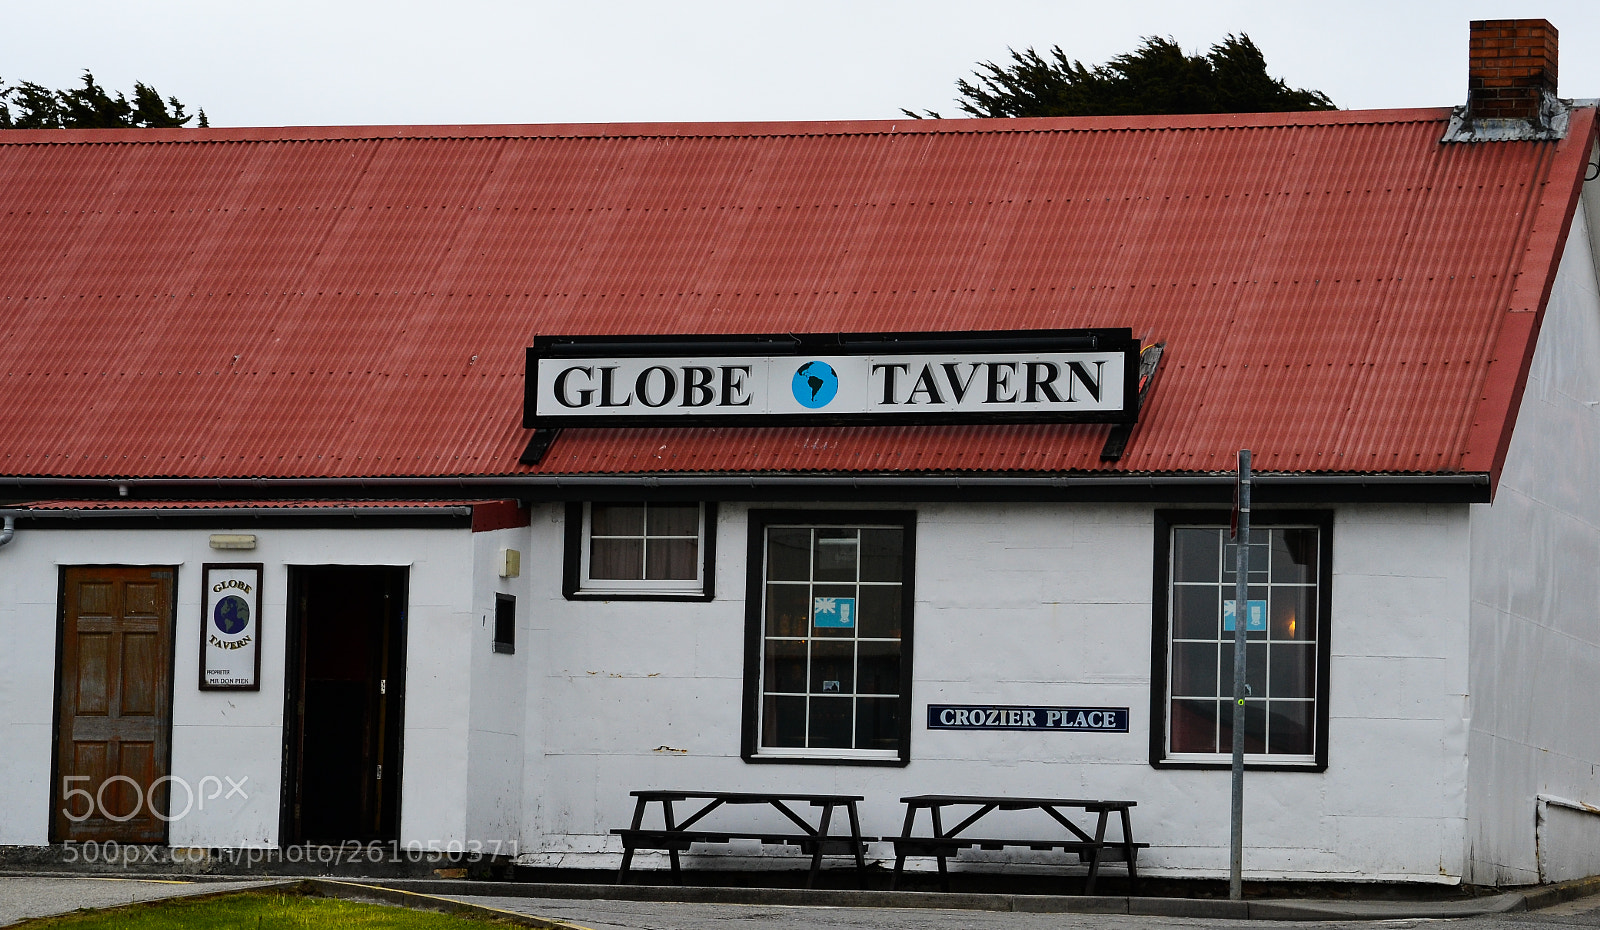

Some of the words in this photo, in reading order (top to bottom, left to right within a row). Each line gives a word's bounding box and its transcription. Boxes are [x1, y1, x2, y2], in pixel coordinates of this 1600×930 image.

[553, 365, 754, 408] GLOBE
[872, 361, 1109, 405] TAVERN
[212, 579, 253, 595] GLOBE
[208, 634, 253, 650] TAVERN
[939, 709, 1037, 726] CROZIER
[1046, 710, 1117, 728] PLACE
